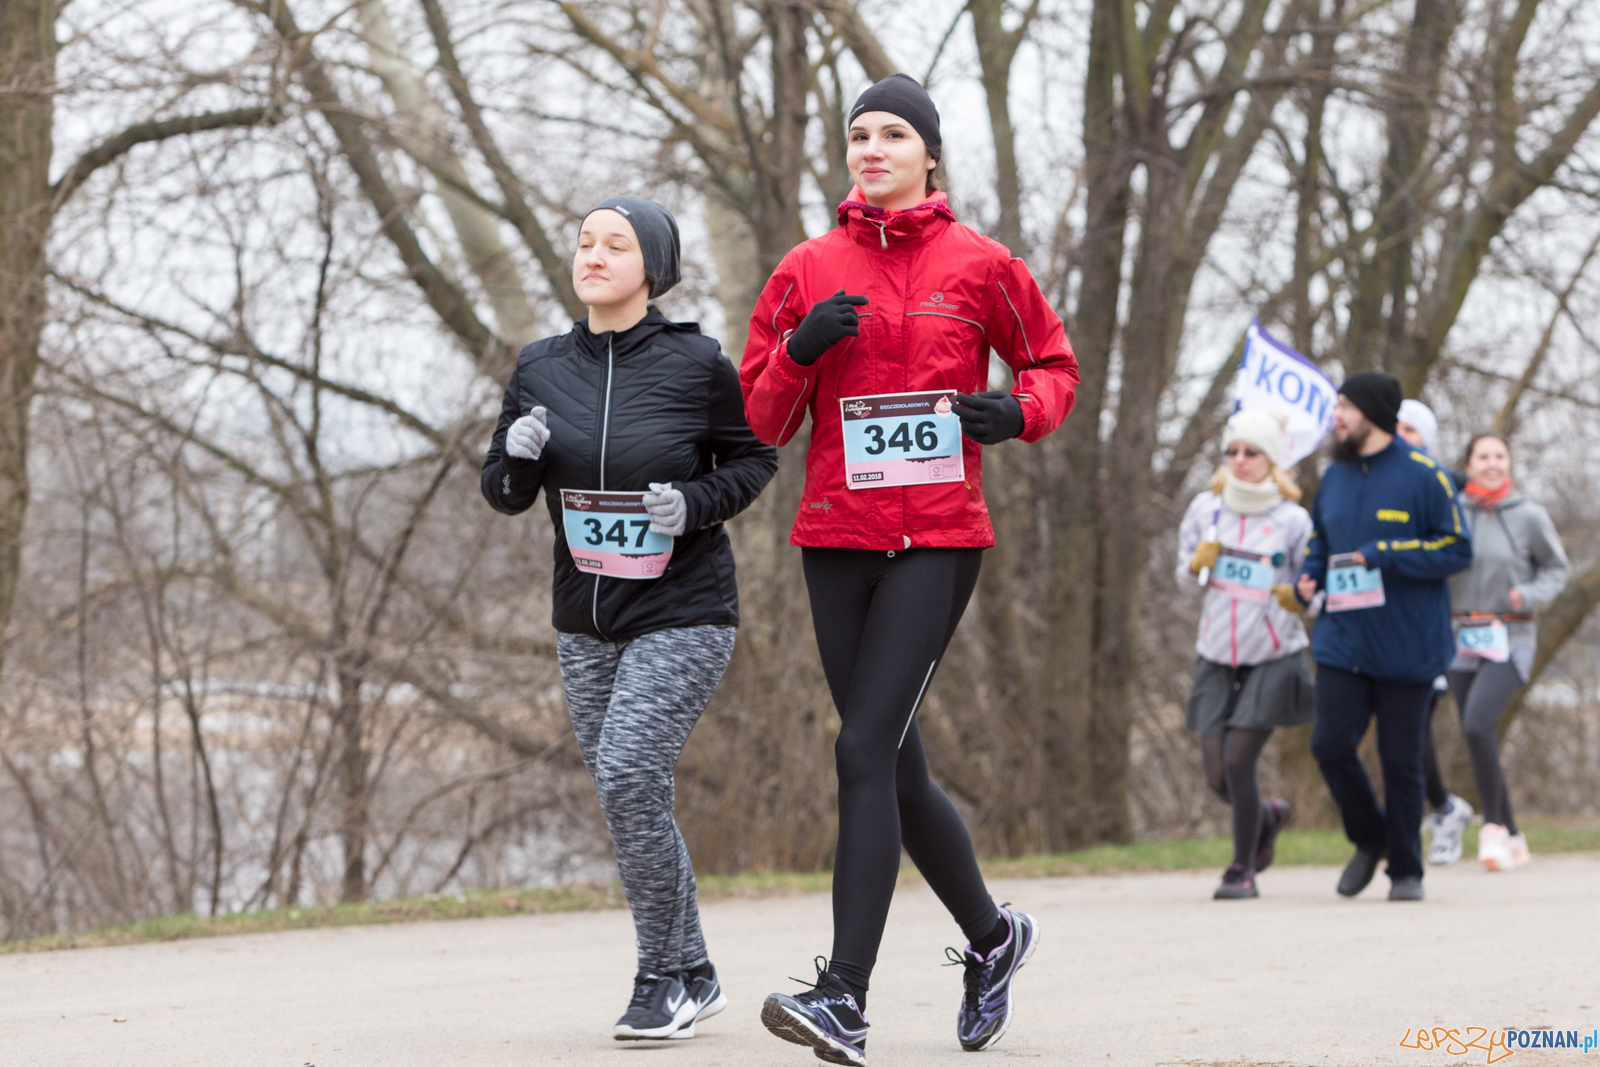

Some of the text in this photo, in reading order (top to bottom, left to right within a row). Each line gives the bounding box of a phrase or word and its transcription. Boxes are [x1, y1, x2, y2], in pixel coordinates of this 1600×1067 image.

[880, 402, 931, 410] BIEGCZEKOLADOWY.PL
[863, 420, 939, 455] 346
[852, 472, 882, 482] 11.02.2018
[583, 517, 651, 548] 347
[1225, 561, 1252, 582] 50
[1336, 571, 1359, 591] 51
